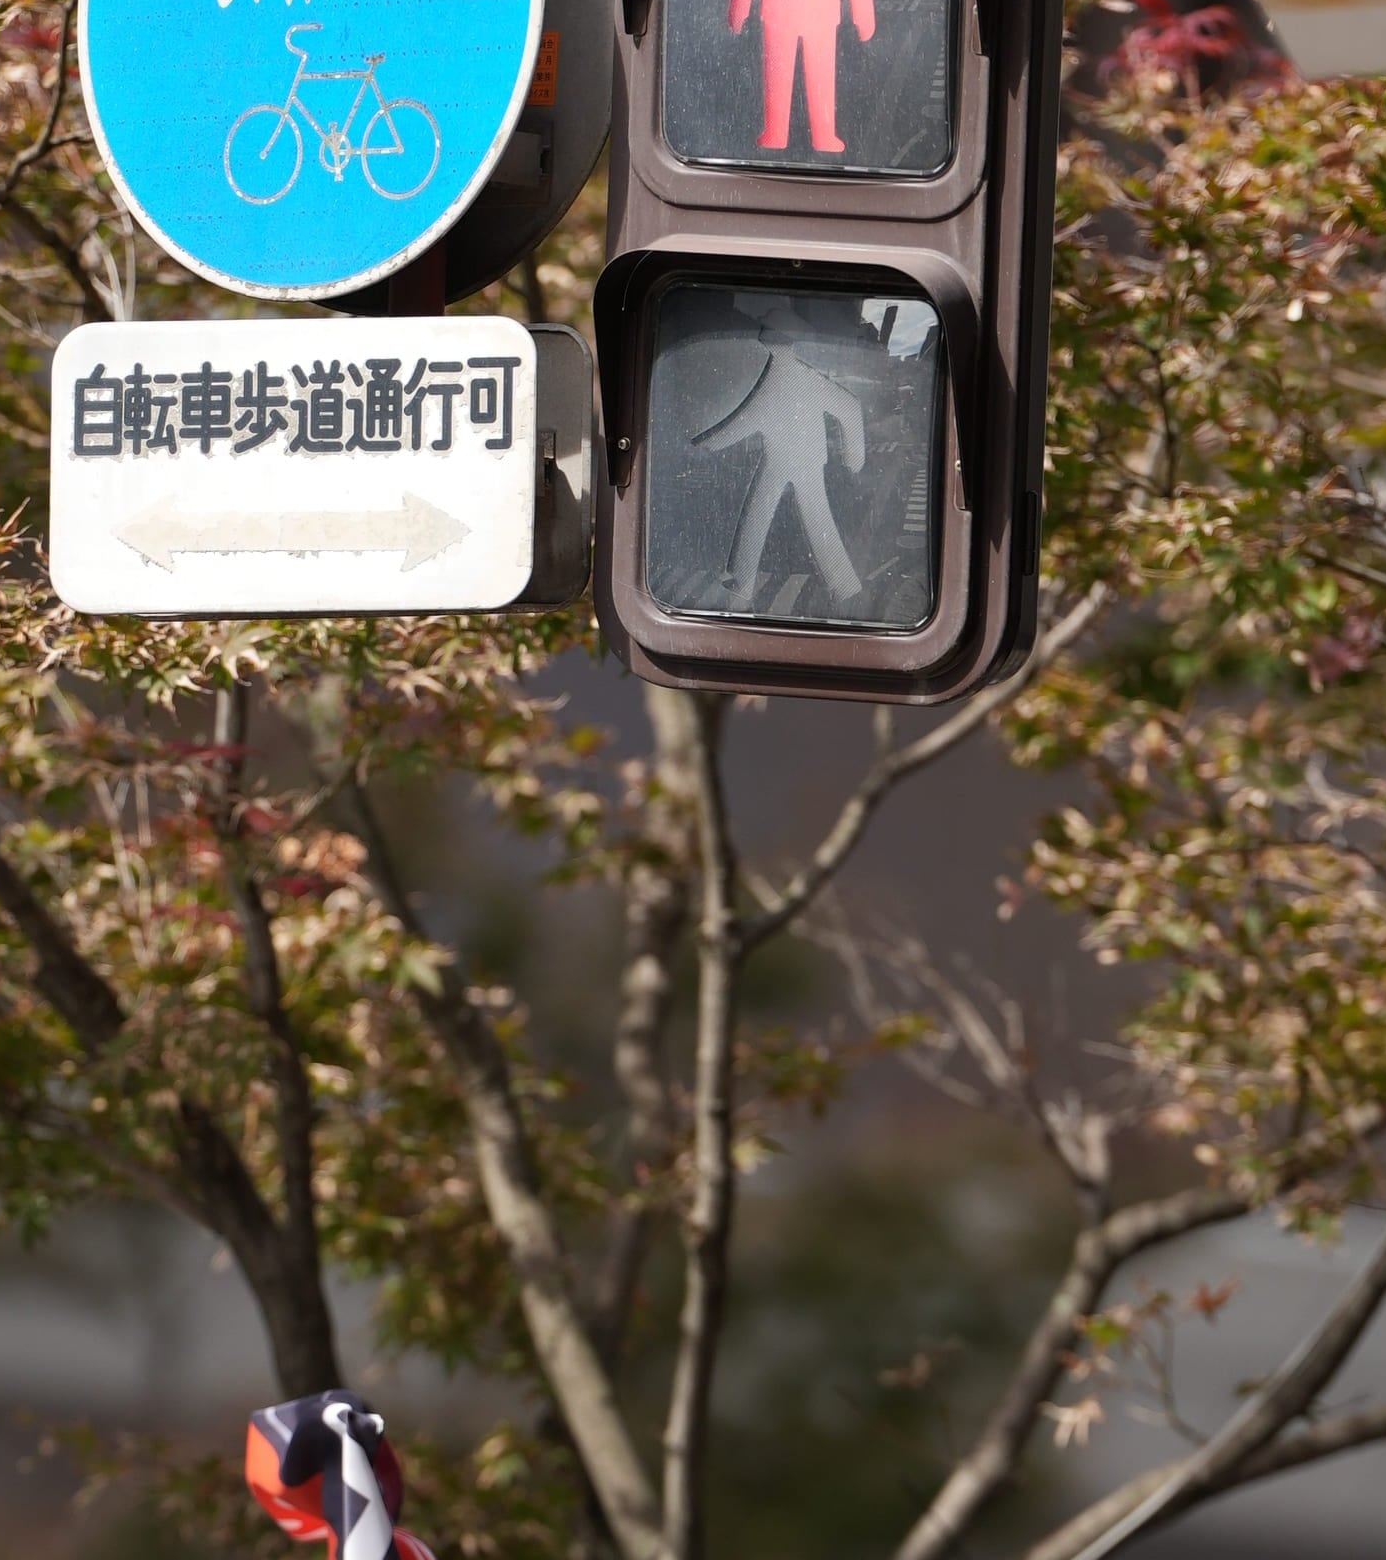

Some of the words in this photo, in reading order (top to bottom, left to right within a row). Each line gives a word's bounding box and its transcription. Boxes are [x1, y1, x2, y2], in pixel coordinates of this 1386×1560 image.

[73, 357, 522, 457] 自転車歩道通行可
